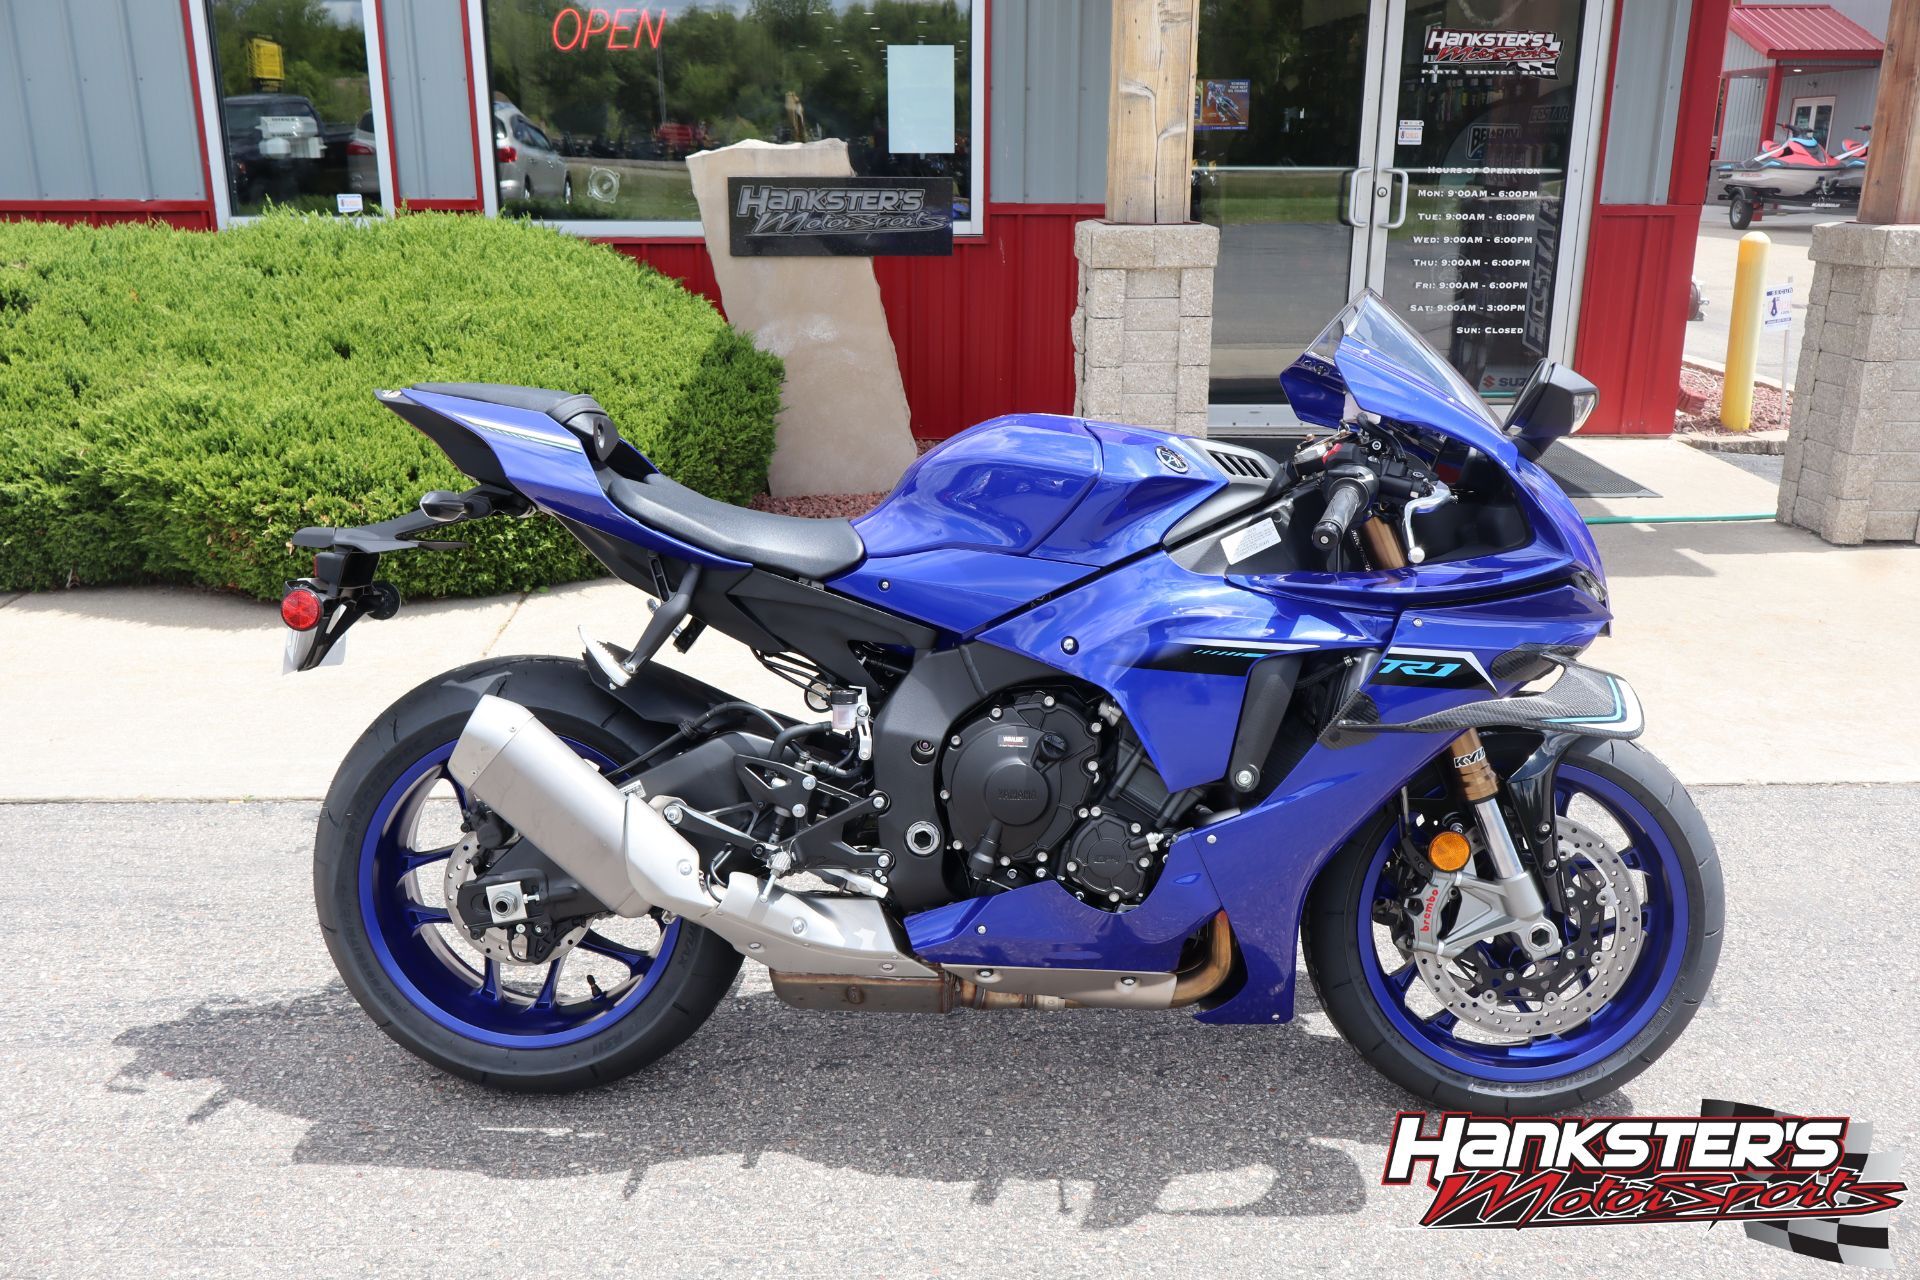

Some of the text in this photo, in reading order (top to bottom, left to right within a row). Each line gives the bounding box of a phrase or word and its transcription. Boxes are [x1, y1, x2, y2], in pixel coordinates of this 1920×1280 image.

[552, 8, 667, 51] OPEN
[1448, 190, 1488, 198] 9:00AM
[1445, 213, 1485, 221] 9:00AM
[1496, 213, 1535, 221] 6:00PM
[1443, 236, 1483, 244] 9:00AM
[1494, 236, 1533, 244] 6:00PM
[1441, 259, 1481, 267] 9:00AM
[1491, 259, 1530, 267] 6:00PM
[1437, 304, 1476, 312] 9:00AM
[1487, 304, 1526, 312] 3:00PM
[1499, 377, 1527, 387] SUZ
[1454, 747, 1486, 768] KYB
[1419, 889, 1439, 933] brembo
